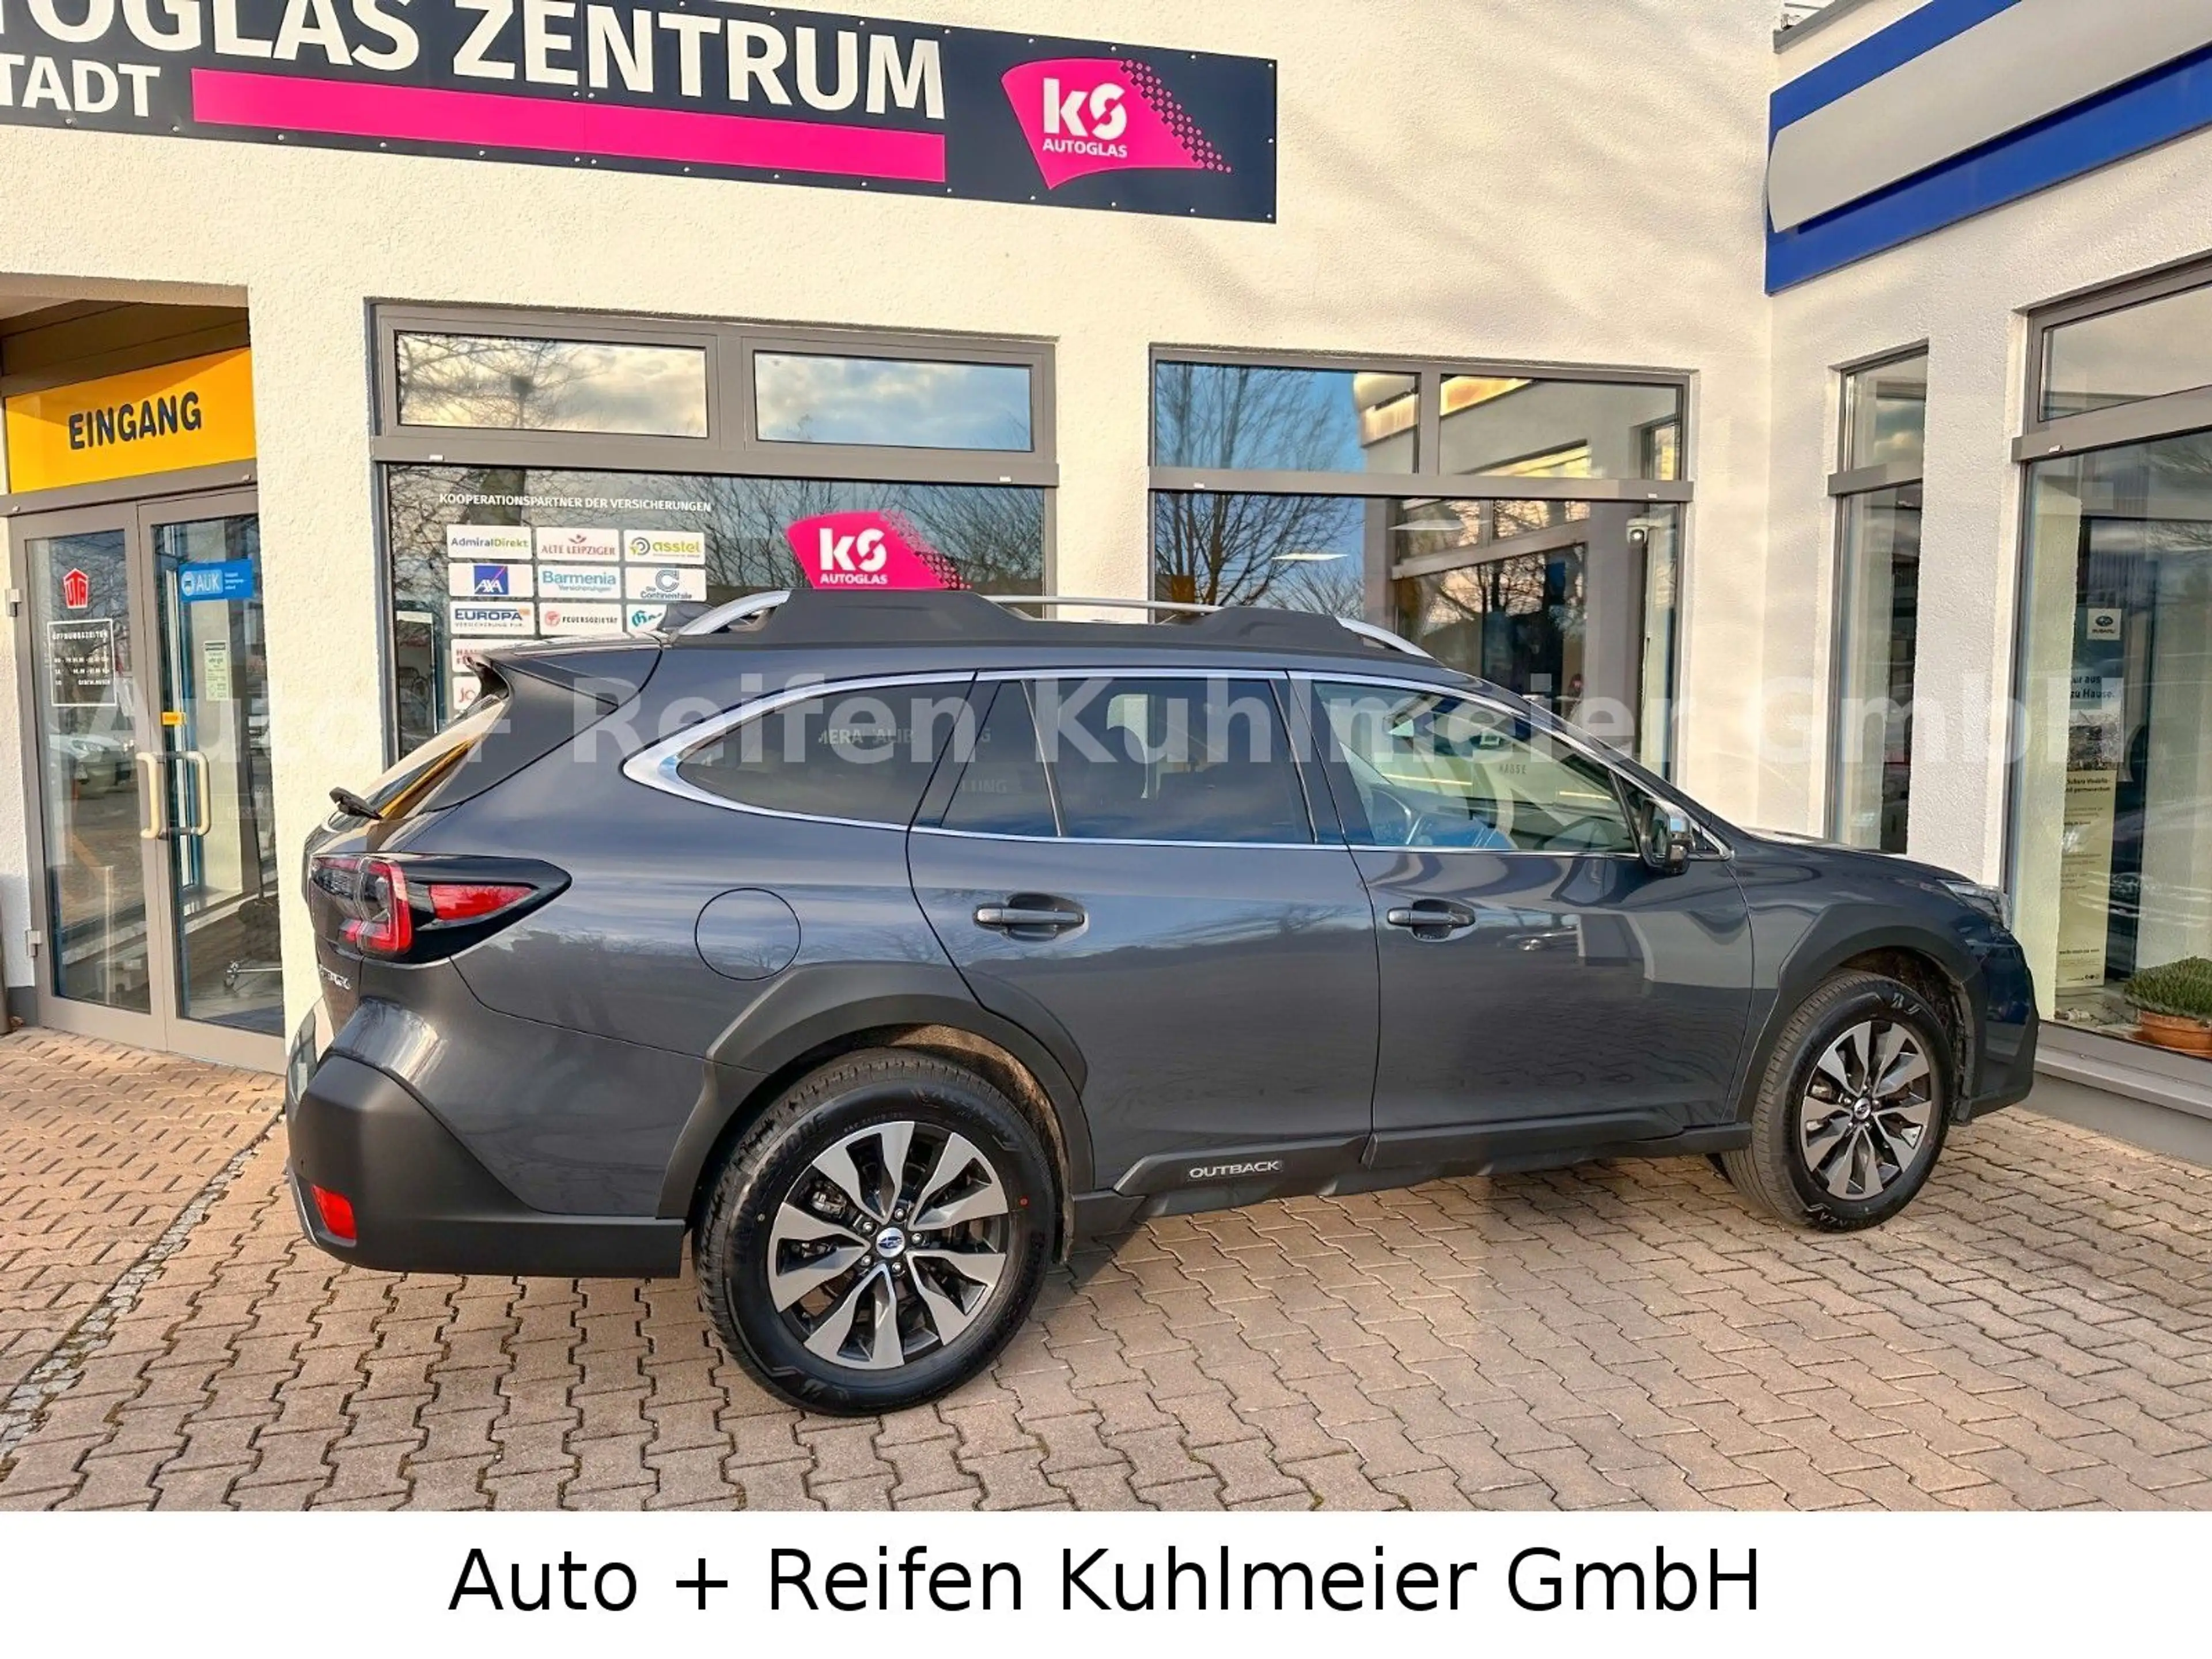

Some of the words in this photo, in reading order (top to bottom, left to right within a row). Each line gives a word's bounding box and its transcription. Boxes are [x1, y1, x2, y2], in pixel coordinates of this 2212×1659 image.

[0, 0, 419, 70] OGLAS
[453, 0, 945, 119] ZENTRUM
[1043, 138, 1127, 158] AUTOGLAS
[69, 391, 202, 450] EINGANG
[439, 494, 582, 508] KOOPERATIONSPARTNER
[585, 498, 608, 509] DER
[609, 498, 712, 512] VERSICHERUNGEN
[450, 537, 529, 548] AdmiralDirekt
[652, 540, 700, 552] asstel
[541, 544, 564, 555] ALTE
[566, 545, 615, 556] LEIPZIGER
[542, 570, 616, 585] Barmenia
[820, 573, 888, 585] AUTOGLAS
[474, 579, 504, 593] AXA
[640, 590, 692, 599] Continentale
[454, 608, 524, 621] EUROPA
[1189, 1160, 1281, 1178] OUTBACK
